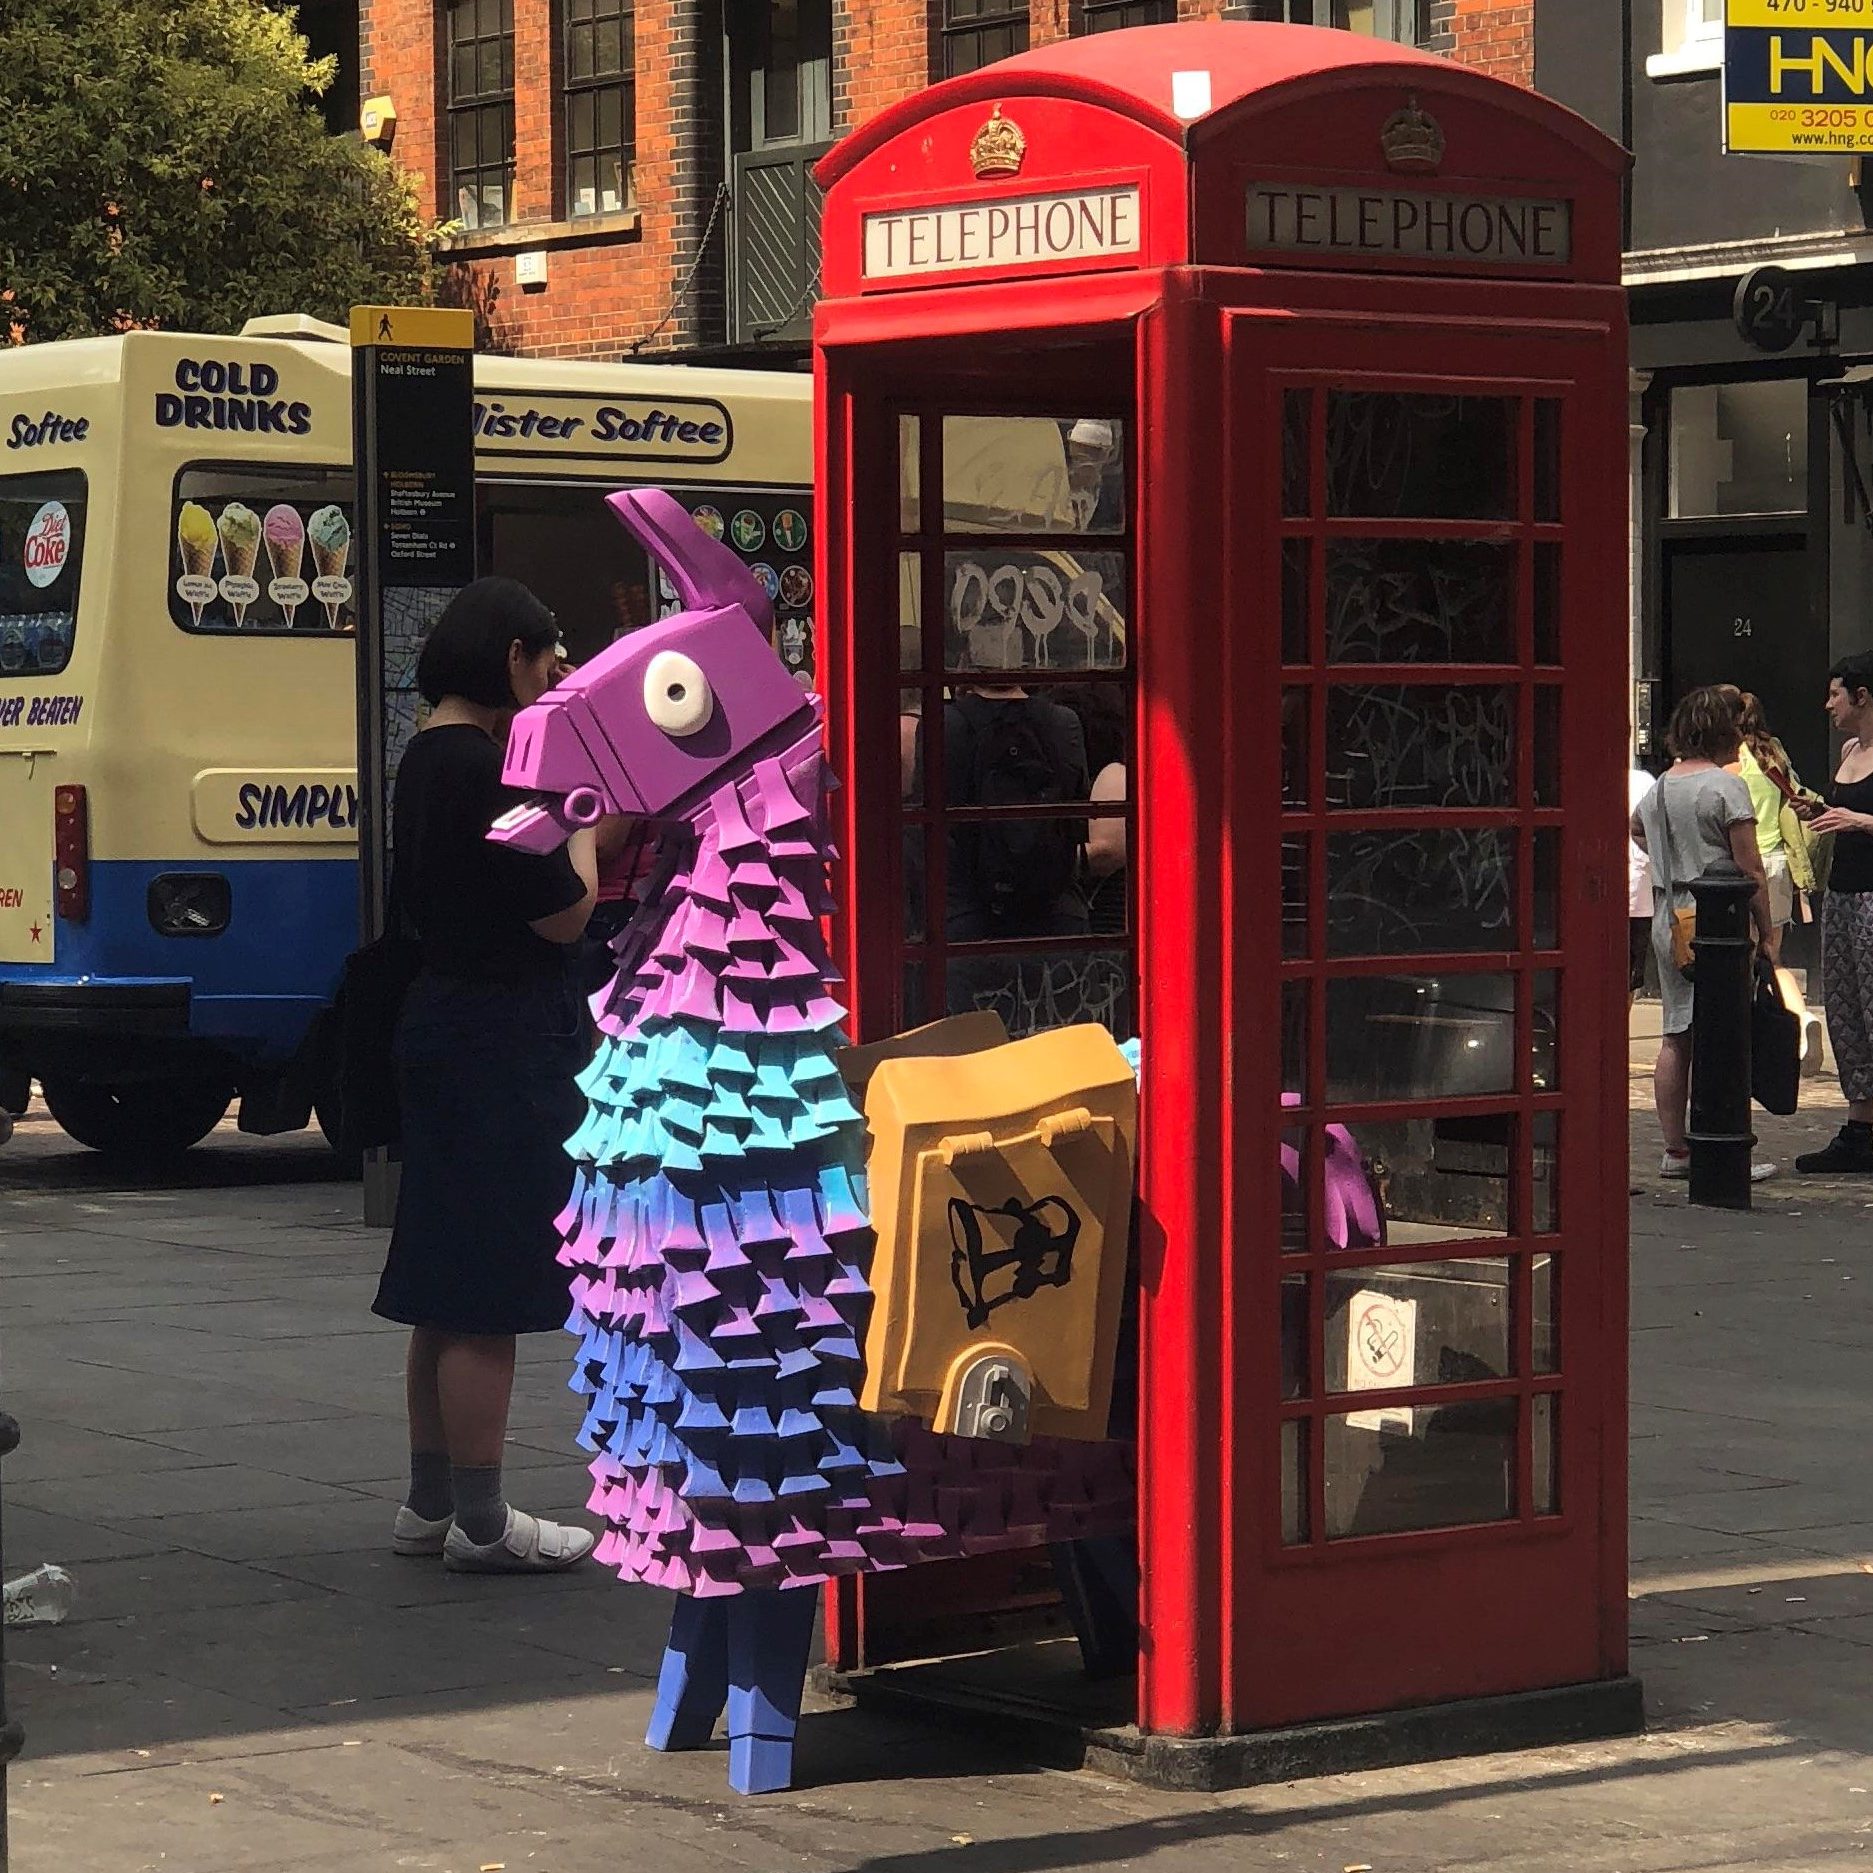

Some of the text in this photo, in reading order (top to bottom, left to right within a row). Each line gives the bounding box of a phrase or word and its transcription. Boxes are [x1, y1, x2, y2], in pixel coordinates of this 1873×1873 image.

[1770, 36, 1873, 94] HN
[1770, 110, 1796, 120] 020
[1801, 109, 1857, 128] 3205
[877, 194, 1132, 268] TELEPHONE
[1256, 191, 1556, 256] TELEPHONE
[1752, 285, 1794, 329] 24
[175, 358, 279, 396] COLD
[380, 352, 465, 365] COVENT GARDEN
[380, 364, 437, 377] Neal Street
[7, 411, 90, 450] Softee
[155, 393, 312, 435] DRINKS
[590, 406, 724, 445] Softee
[42, 512, 67, 534] Diet
[25, 535, 65, 569] Coke
[1734, 618, 1752, 637] 24
[27, 695, 84, 726] BEATEN
